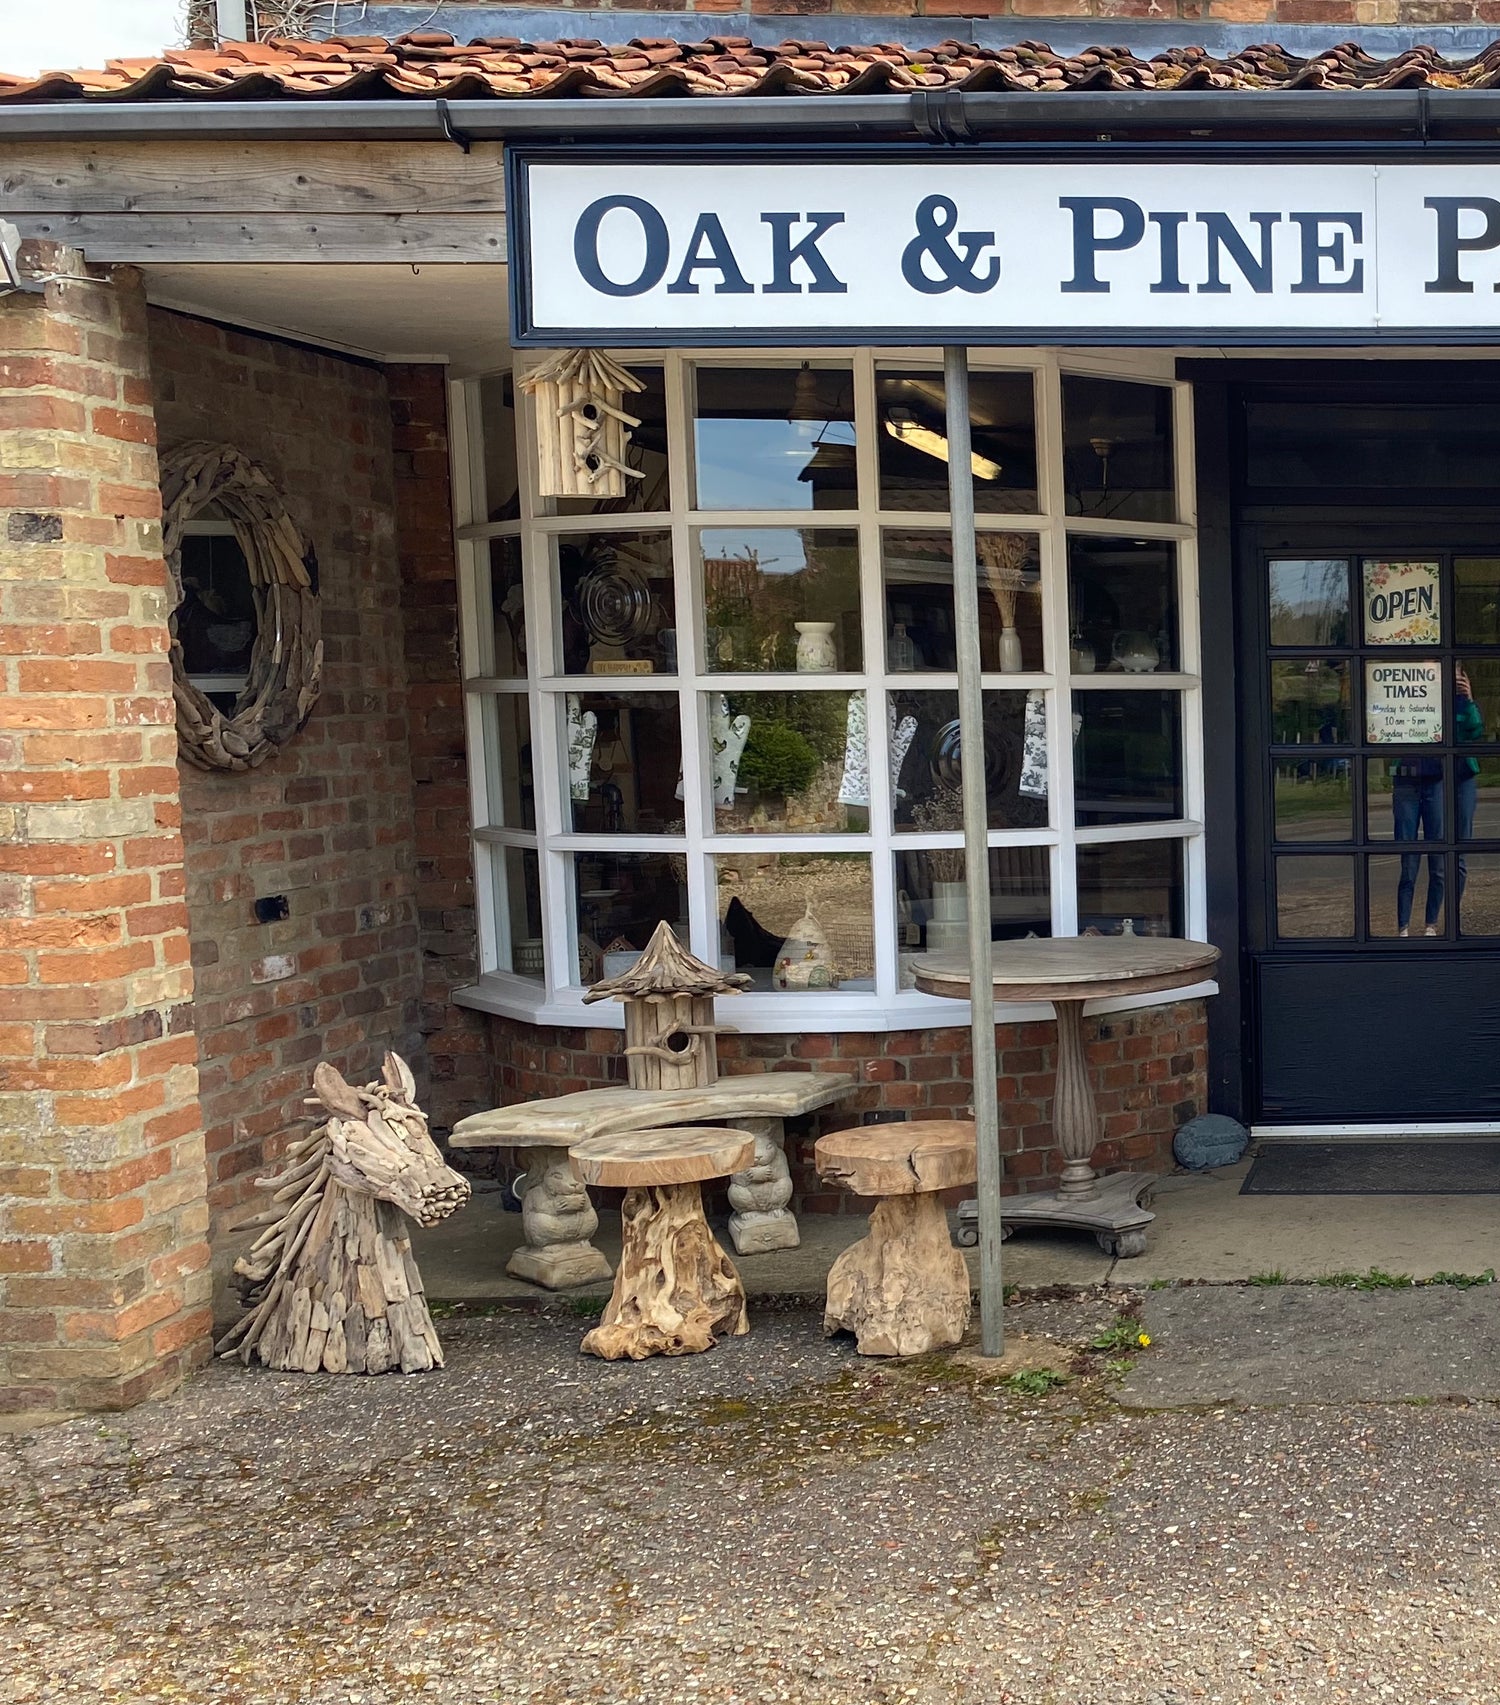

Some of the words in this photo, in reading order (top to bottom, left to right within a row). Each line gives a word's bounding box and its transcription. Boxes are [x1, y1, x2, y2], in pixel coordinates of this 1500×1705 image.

[574, 195, 847, 296] OAK
[902, 194, 1000, 294] &
[1059, 197, 1363, 293] PINE
[1369, 584, 1434, 623] OPEN
[1372, 668, 1436, 682] OPENING
[1383, 685, 1428, 698] TIMES
[1372, 704, 1397, 715] Monday
[1399, 704, 1405, 713] to
[1408, 703, 1436, 715] Saturday
